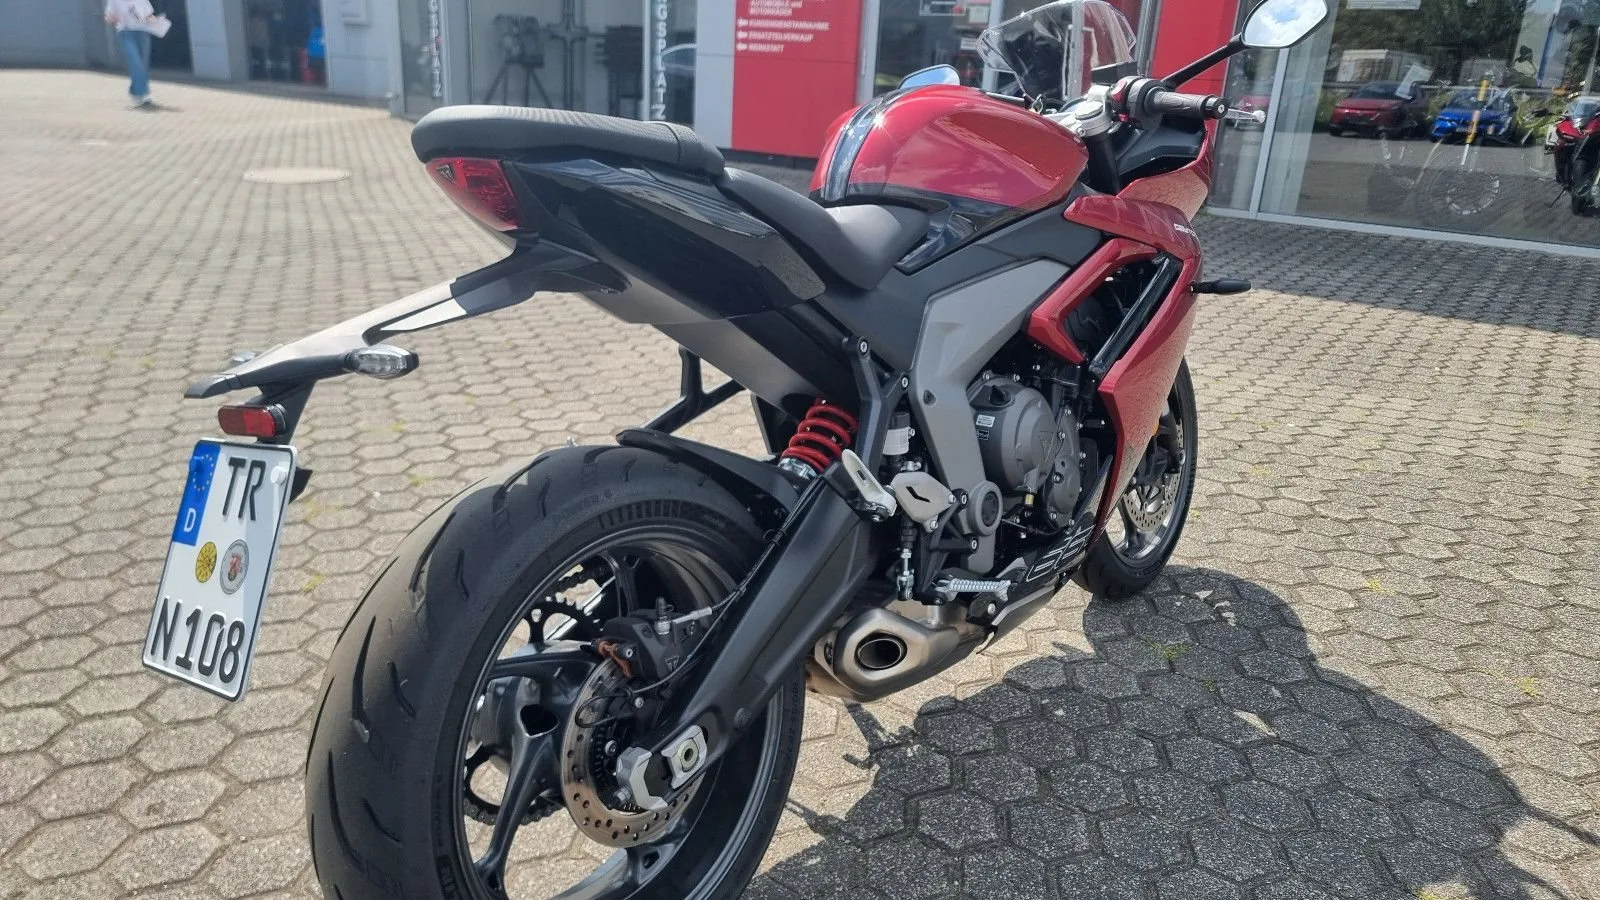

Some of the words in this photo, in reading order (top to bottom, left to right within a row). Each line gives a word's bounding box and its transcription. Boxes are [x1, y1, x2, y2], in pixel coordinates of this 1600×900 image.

[652, 0, 668, 120] GSPLATZ
[183, 508, 197, 533] D
[222, 456, 267, 521] TR
